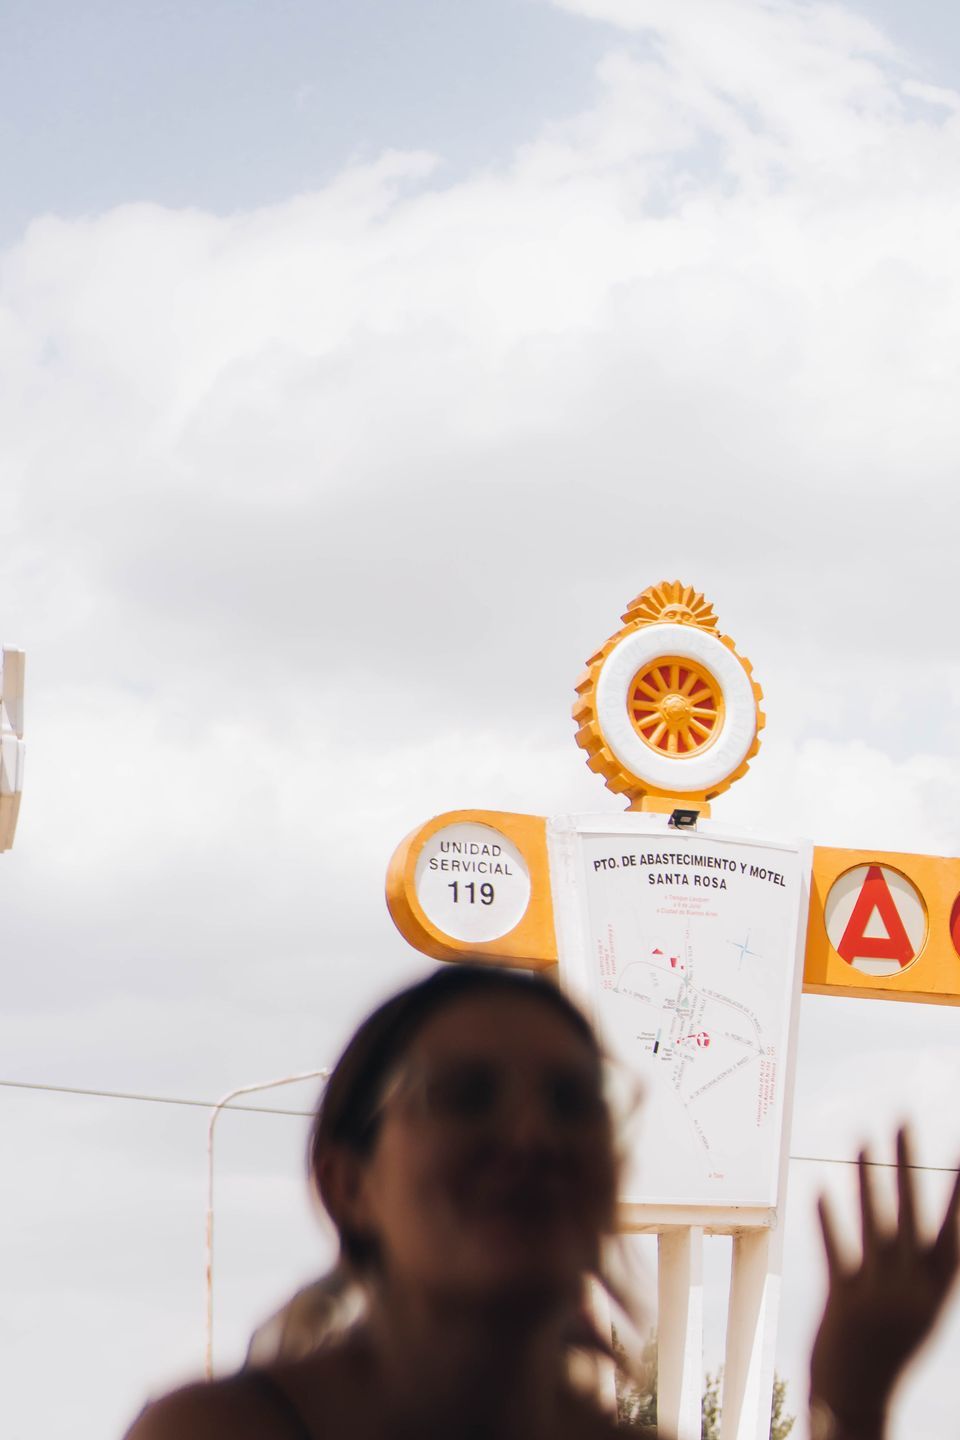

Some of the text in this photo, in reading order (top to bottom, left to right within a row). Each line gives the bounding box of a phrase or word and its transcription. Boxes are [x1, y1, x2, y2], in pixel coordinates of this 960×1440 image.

[440, 840, 502, 857] UNIDAD
[429, 857, 513, 876] SERVICIAL
[593, 853, 787, 888] PTO. DE ABASTECIMIENTO Y MOTEL
[648, 873, 728, 891] SANTA ROSA
[447, 880, 495, 906] 119
